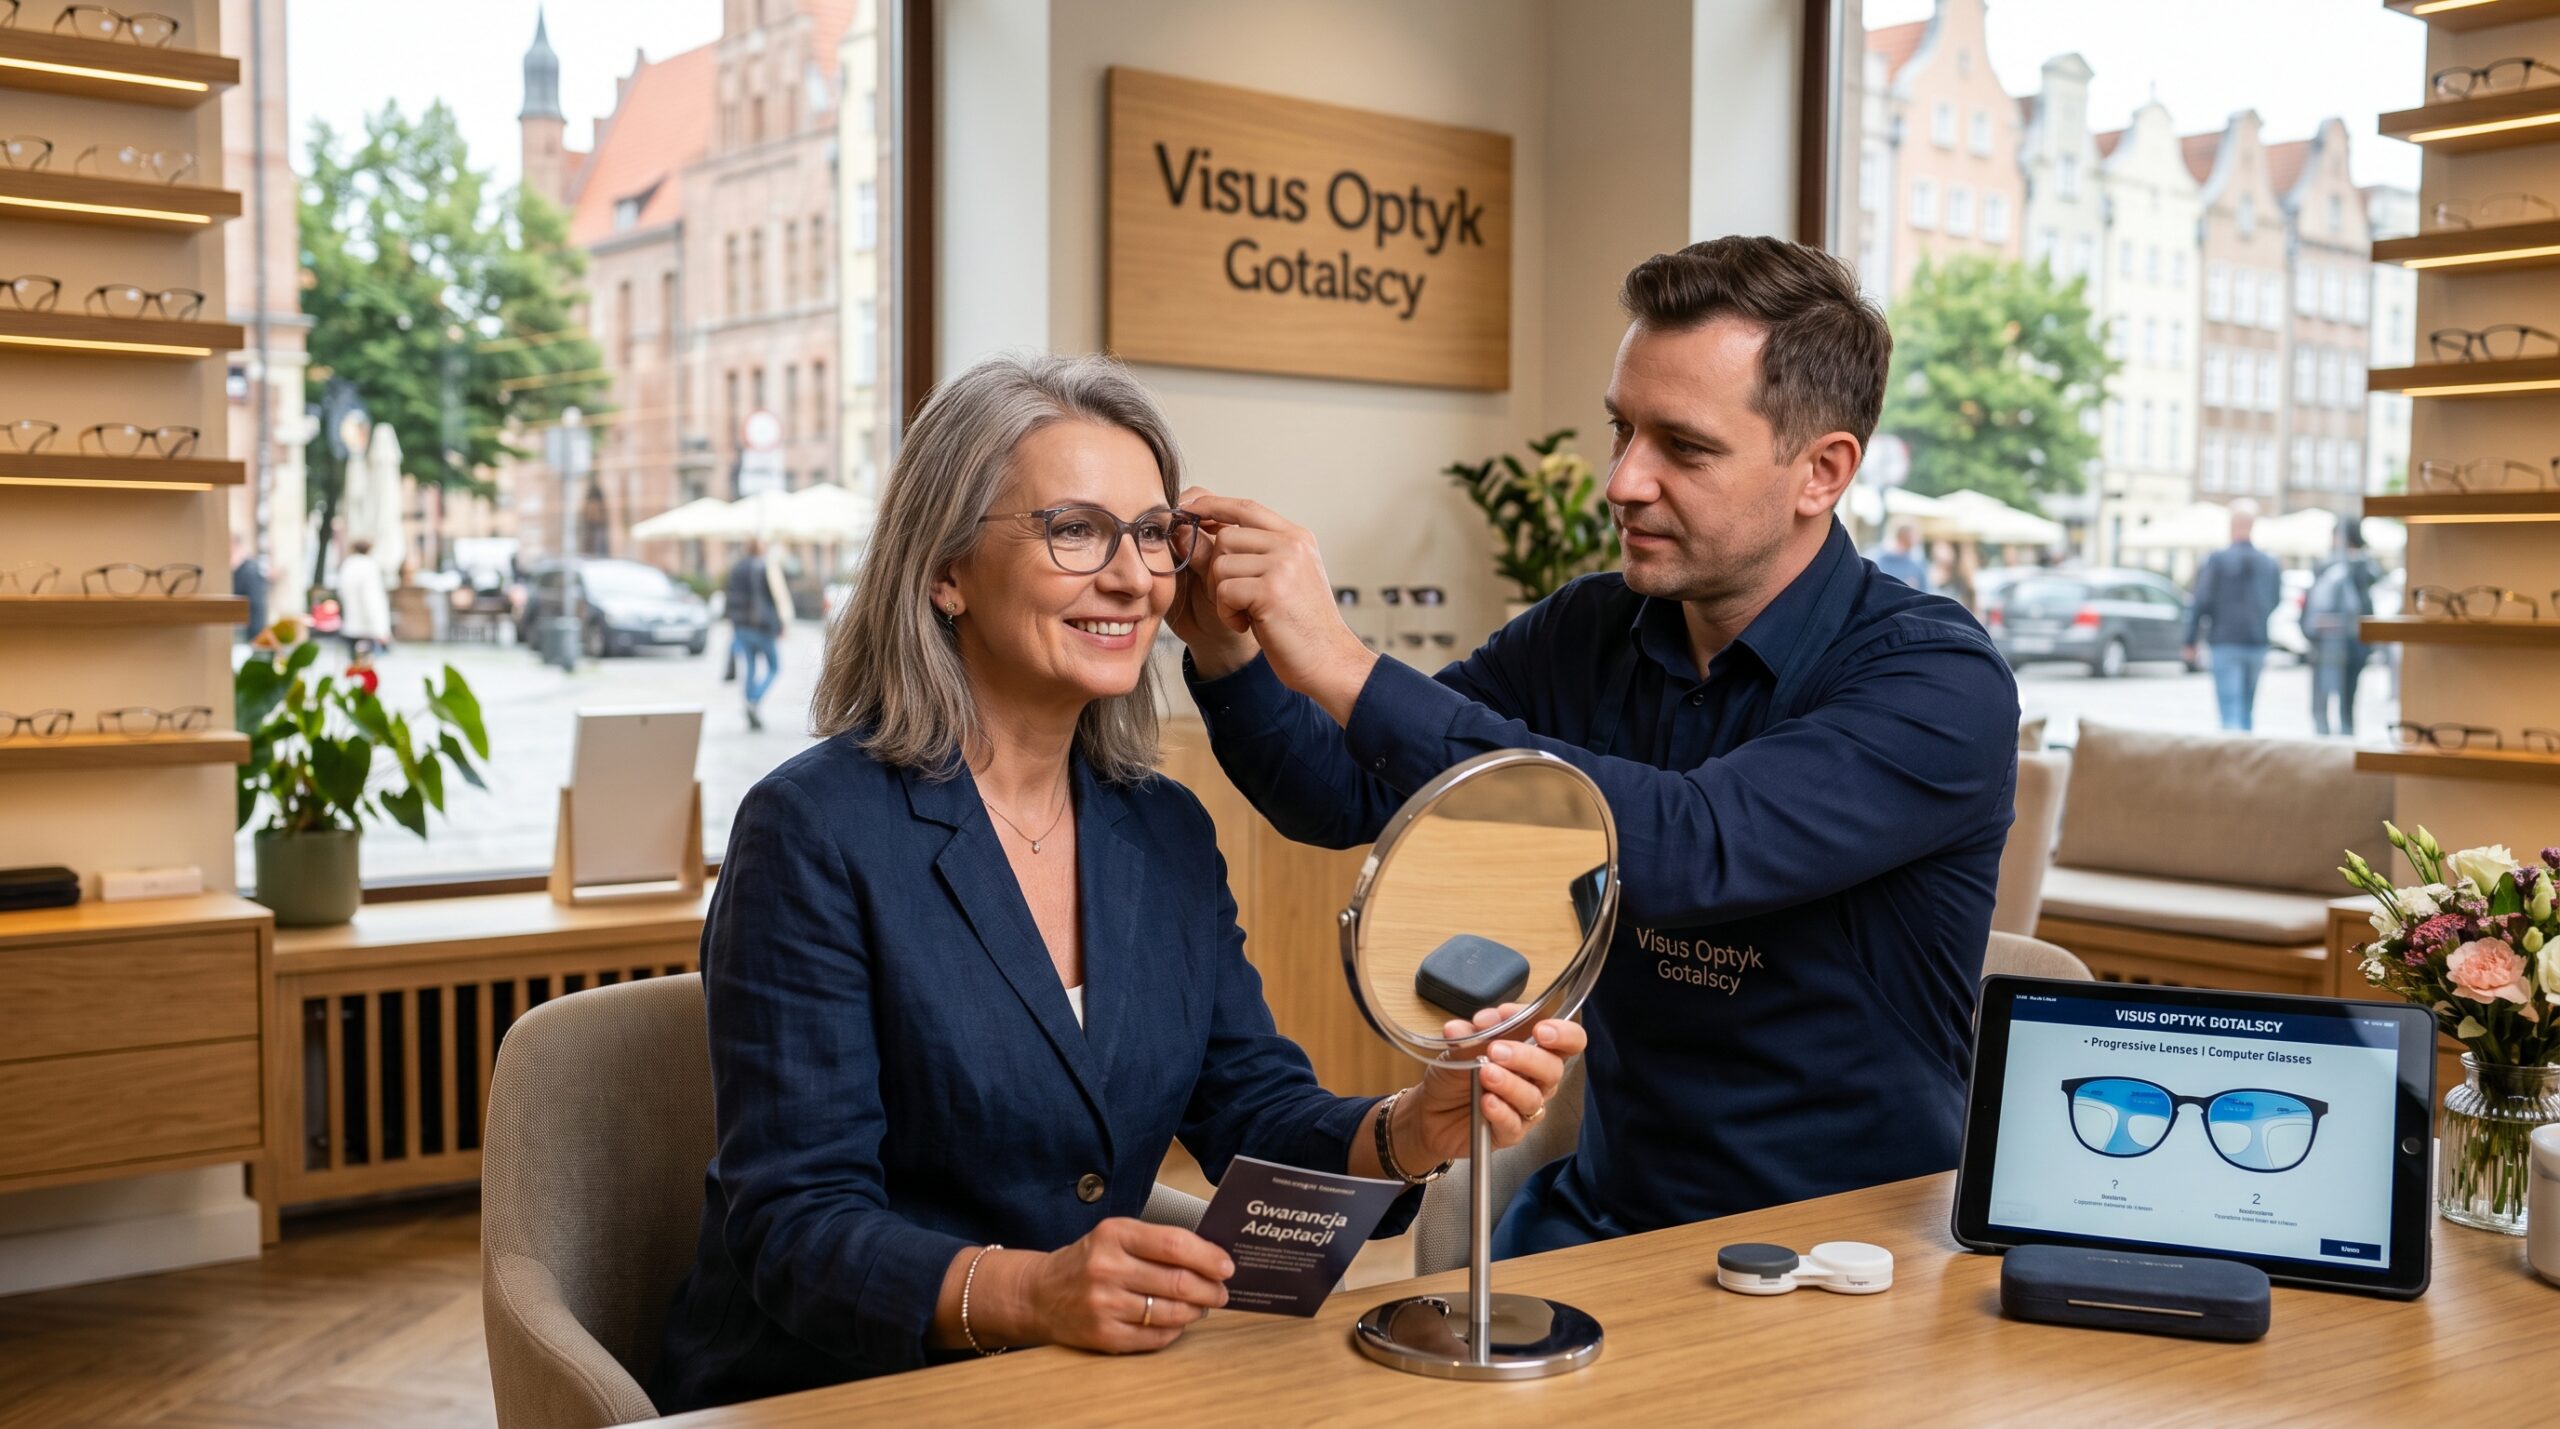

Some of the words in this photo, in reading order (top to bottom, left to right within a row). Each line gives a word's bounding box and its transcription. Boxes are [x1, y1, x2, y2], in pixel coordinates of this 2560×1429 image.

[1154, 141, 1308, 224] Visus
[1326, 170, 1485, 256] Optyk
[1224, 238, 1425, 321] Gotalscy
[1636, 927, 1690, 958] Visus
[1695, 939, 1764, 973] Optyk
[1657, 959, 1741, 996] Gotalscy
[2115, 1009, 2156, 1024] VISUS
[2159, 1012, 2207, 1028] OPTYK
[2091, 1037, 2156, 1052] Progressive
[2159, 1042, 2198, 1056] Lenses
[2208, 1046, 2265, 1062] Computer
[2267, 1051, 2312, 1065] Glasses
[1246, 1199, 1348, 1230] Gwarancja
[2252, 1193, 2261, 1205] 2
[1241, 1220, 1336, 1248] Adaptacji
